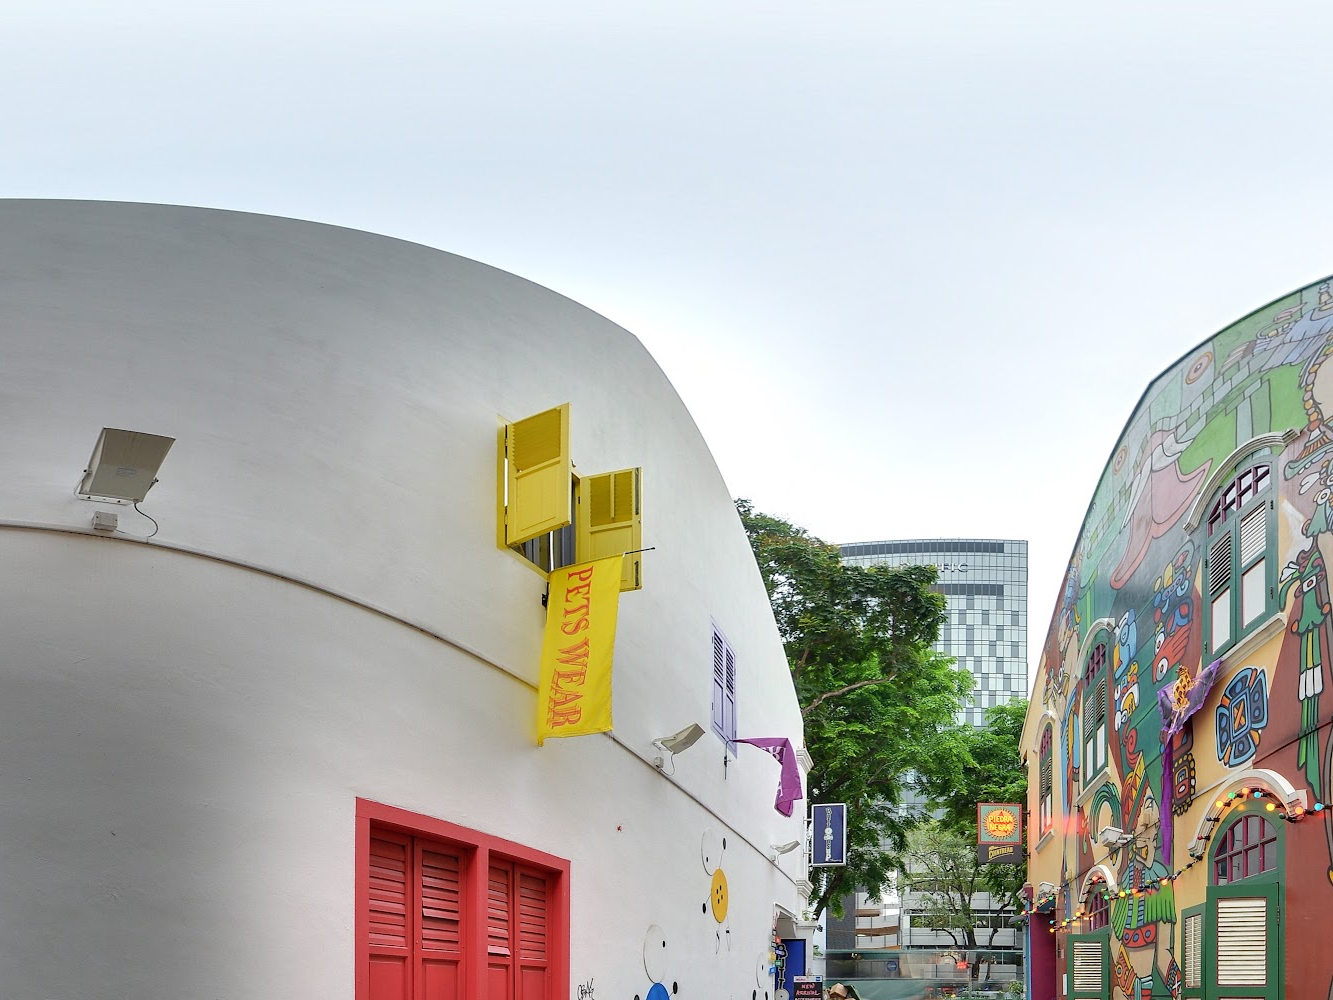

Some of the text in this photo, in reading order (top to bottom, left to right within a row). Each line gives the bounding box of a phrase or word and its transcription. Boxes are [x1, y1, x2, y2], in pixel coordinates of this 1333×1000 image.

[547, 565, 594, 729] PETS WEAR
[988, 815, 1013, 823] PIEDRA
[989, 823, 1011, 831] NEGRA
